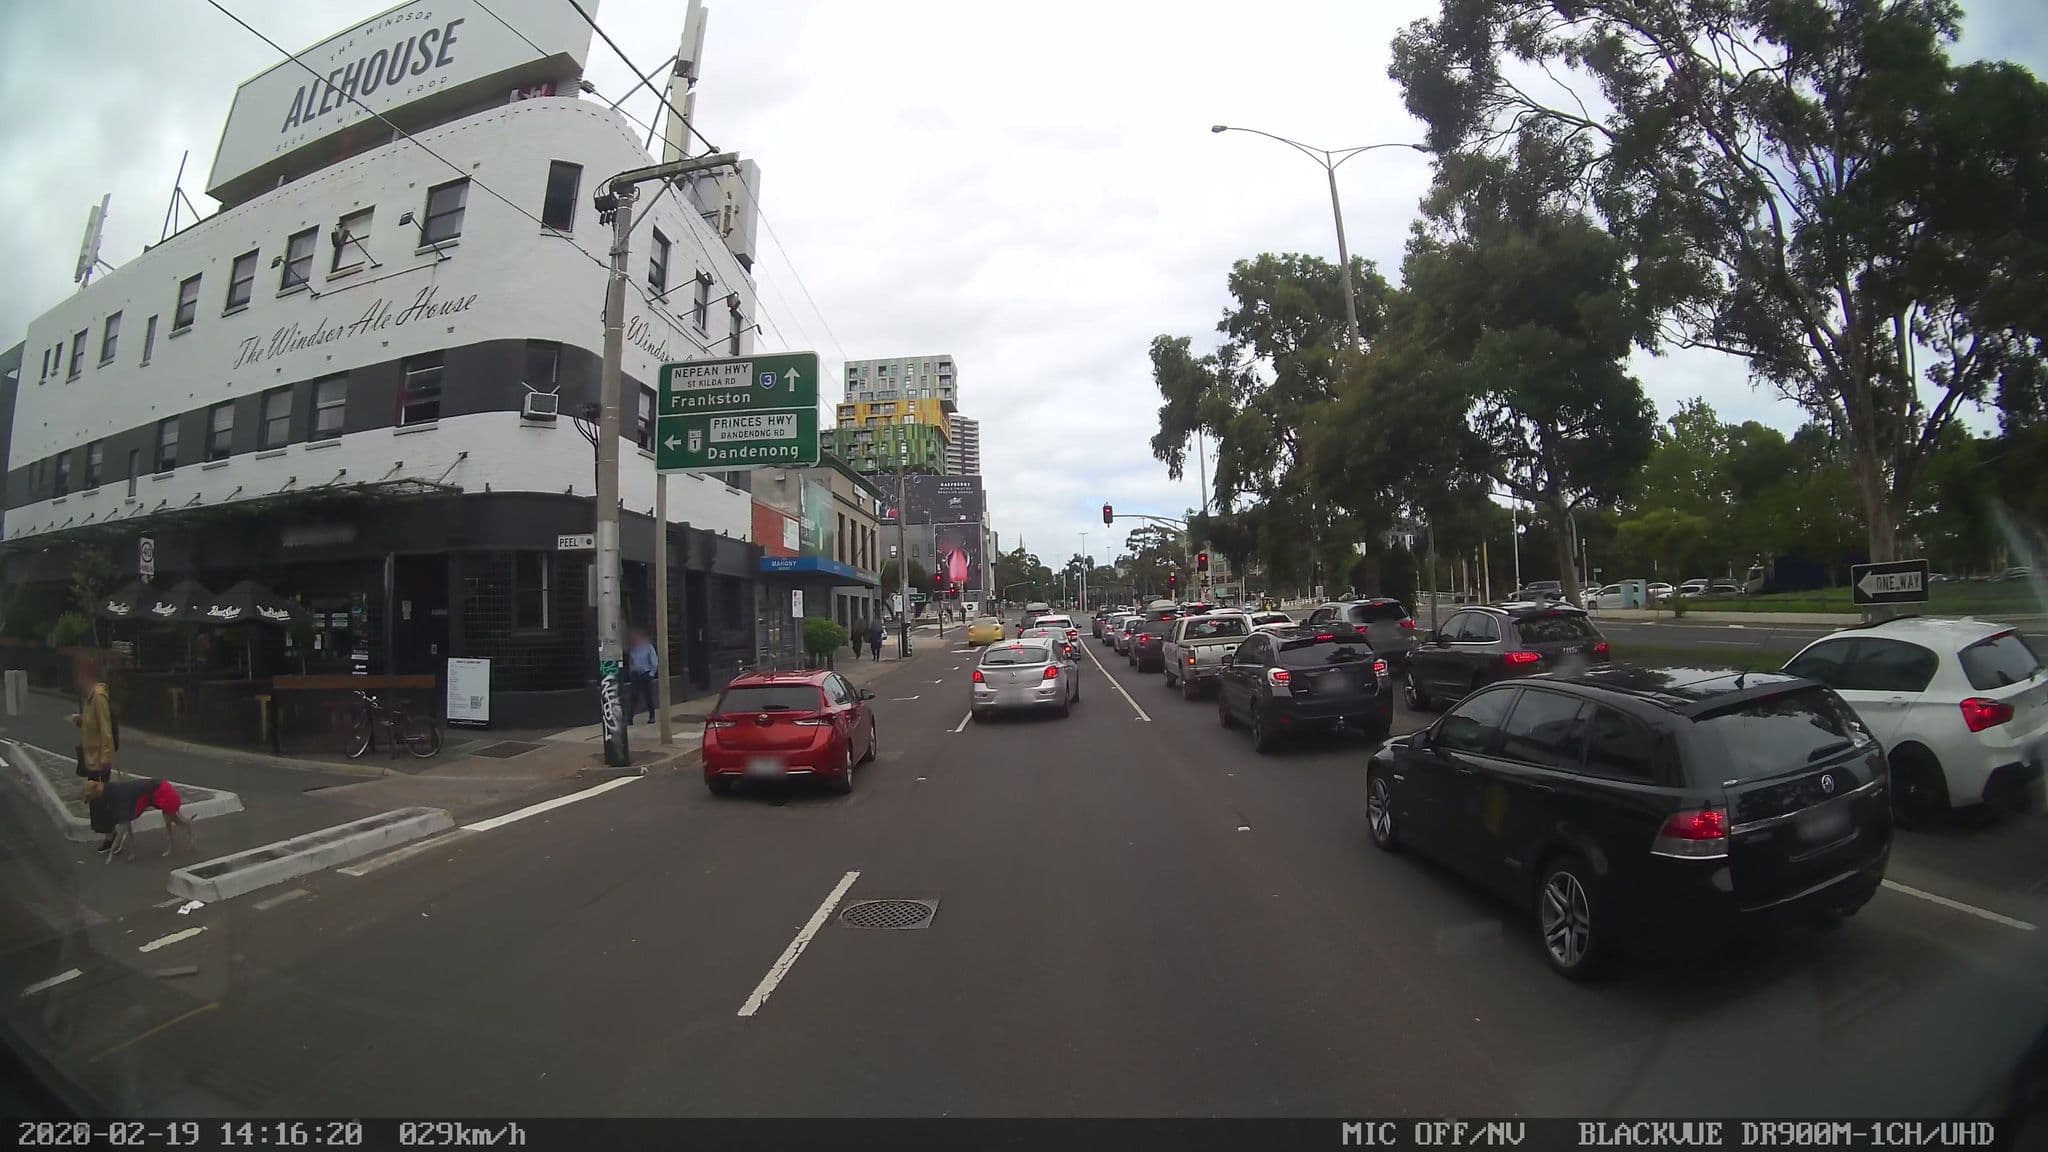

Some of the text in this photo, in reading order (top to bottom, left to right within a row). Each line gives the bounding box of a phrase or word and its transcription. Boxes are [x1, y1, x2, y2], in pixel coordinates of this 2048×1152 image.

[366, 11, 433, 36] WINDSOR
[281, 18, 466, 134] ALEHOUSE
[406, 76, 448, 96] FOOD
[233, 286, 478, 370] The Windsor Ale House
[674, 363, 749, 379] NEPEAN HWY
[687, 377, 736, 388] ST KILDA RD
[763, 374, 772, 384] 3
[671, 392, 751, 408] Frankston
[713, 415, 793, 430] PRINCES HWY
[721, 429, 785, 439] DANDENONG RD
[692, 440, 697, 450] 1
[708, 445, 799, 459] Dandenong
[559, 537, 579, 548] PEEL
[1876, 574, 1920, 590] ONE WAY
